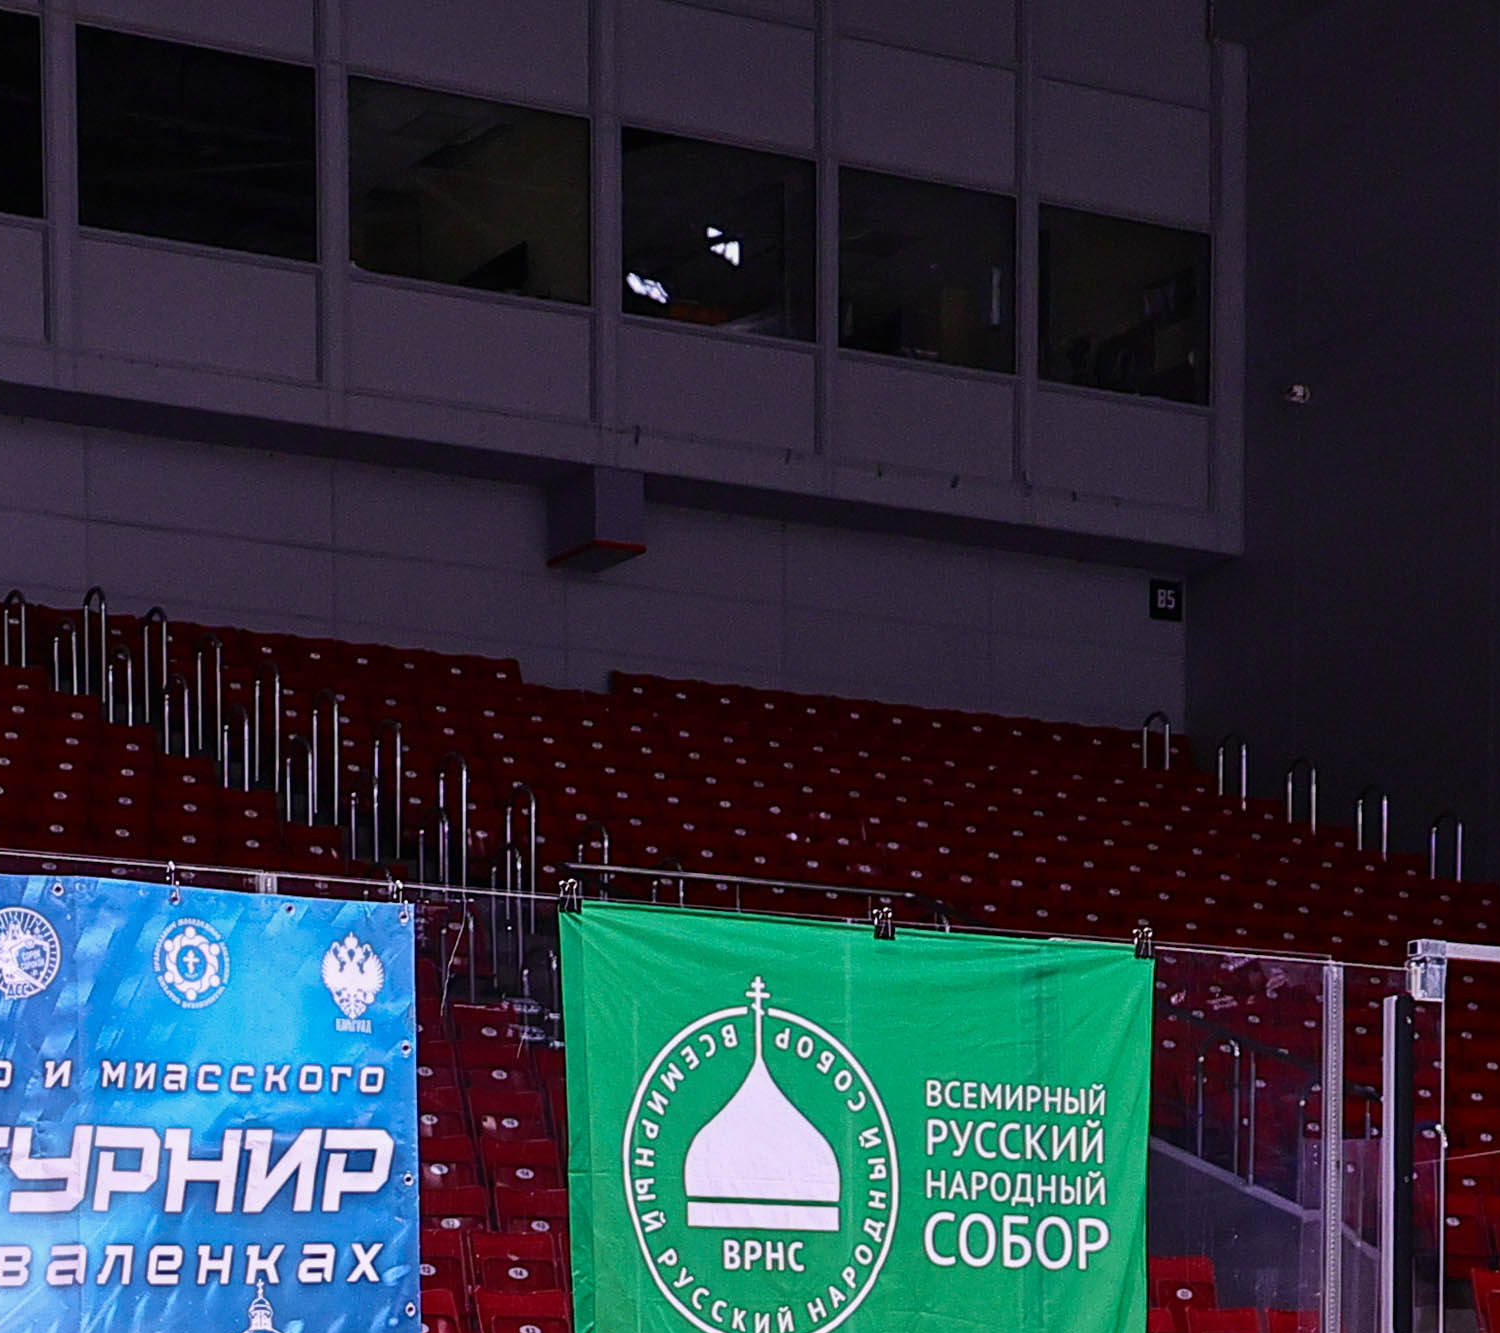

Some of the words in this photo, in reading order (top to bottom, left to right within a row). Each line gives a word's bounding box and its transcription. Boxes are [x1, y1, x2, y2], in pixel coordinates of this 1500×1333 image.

[44, 1058, 74, 1088] И
[774, 1027, 868, 1113] СОБОР
[924, 1079, 1108, 1117] ВСЕМИРНЫЙ
[633, 1024, 739, 1234] ВСЕМИРНЫЙ
[924, 1119, 1106, 1164] РУССКИЙ
[924, 1169, 1107, 1207] НАРОДНЫЙ
[806, 1126, 889, 1325] НАРОДНЫЙ
[922, 1211, 1111, 1271] СОБОР
[722, 1238, 805, 1273] ВРНС
